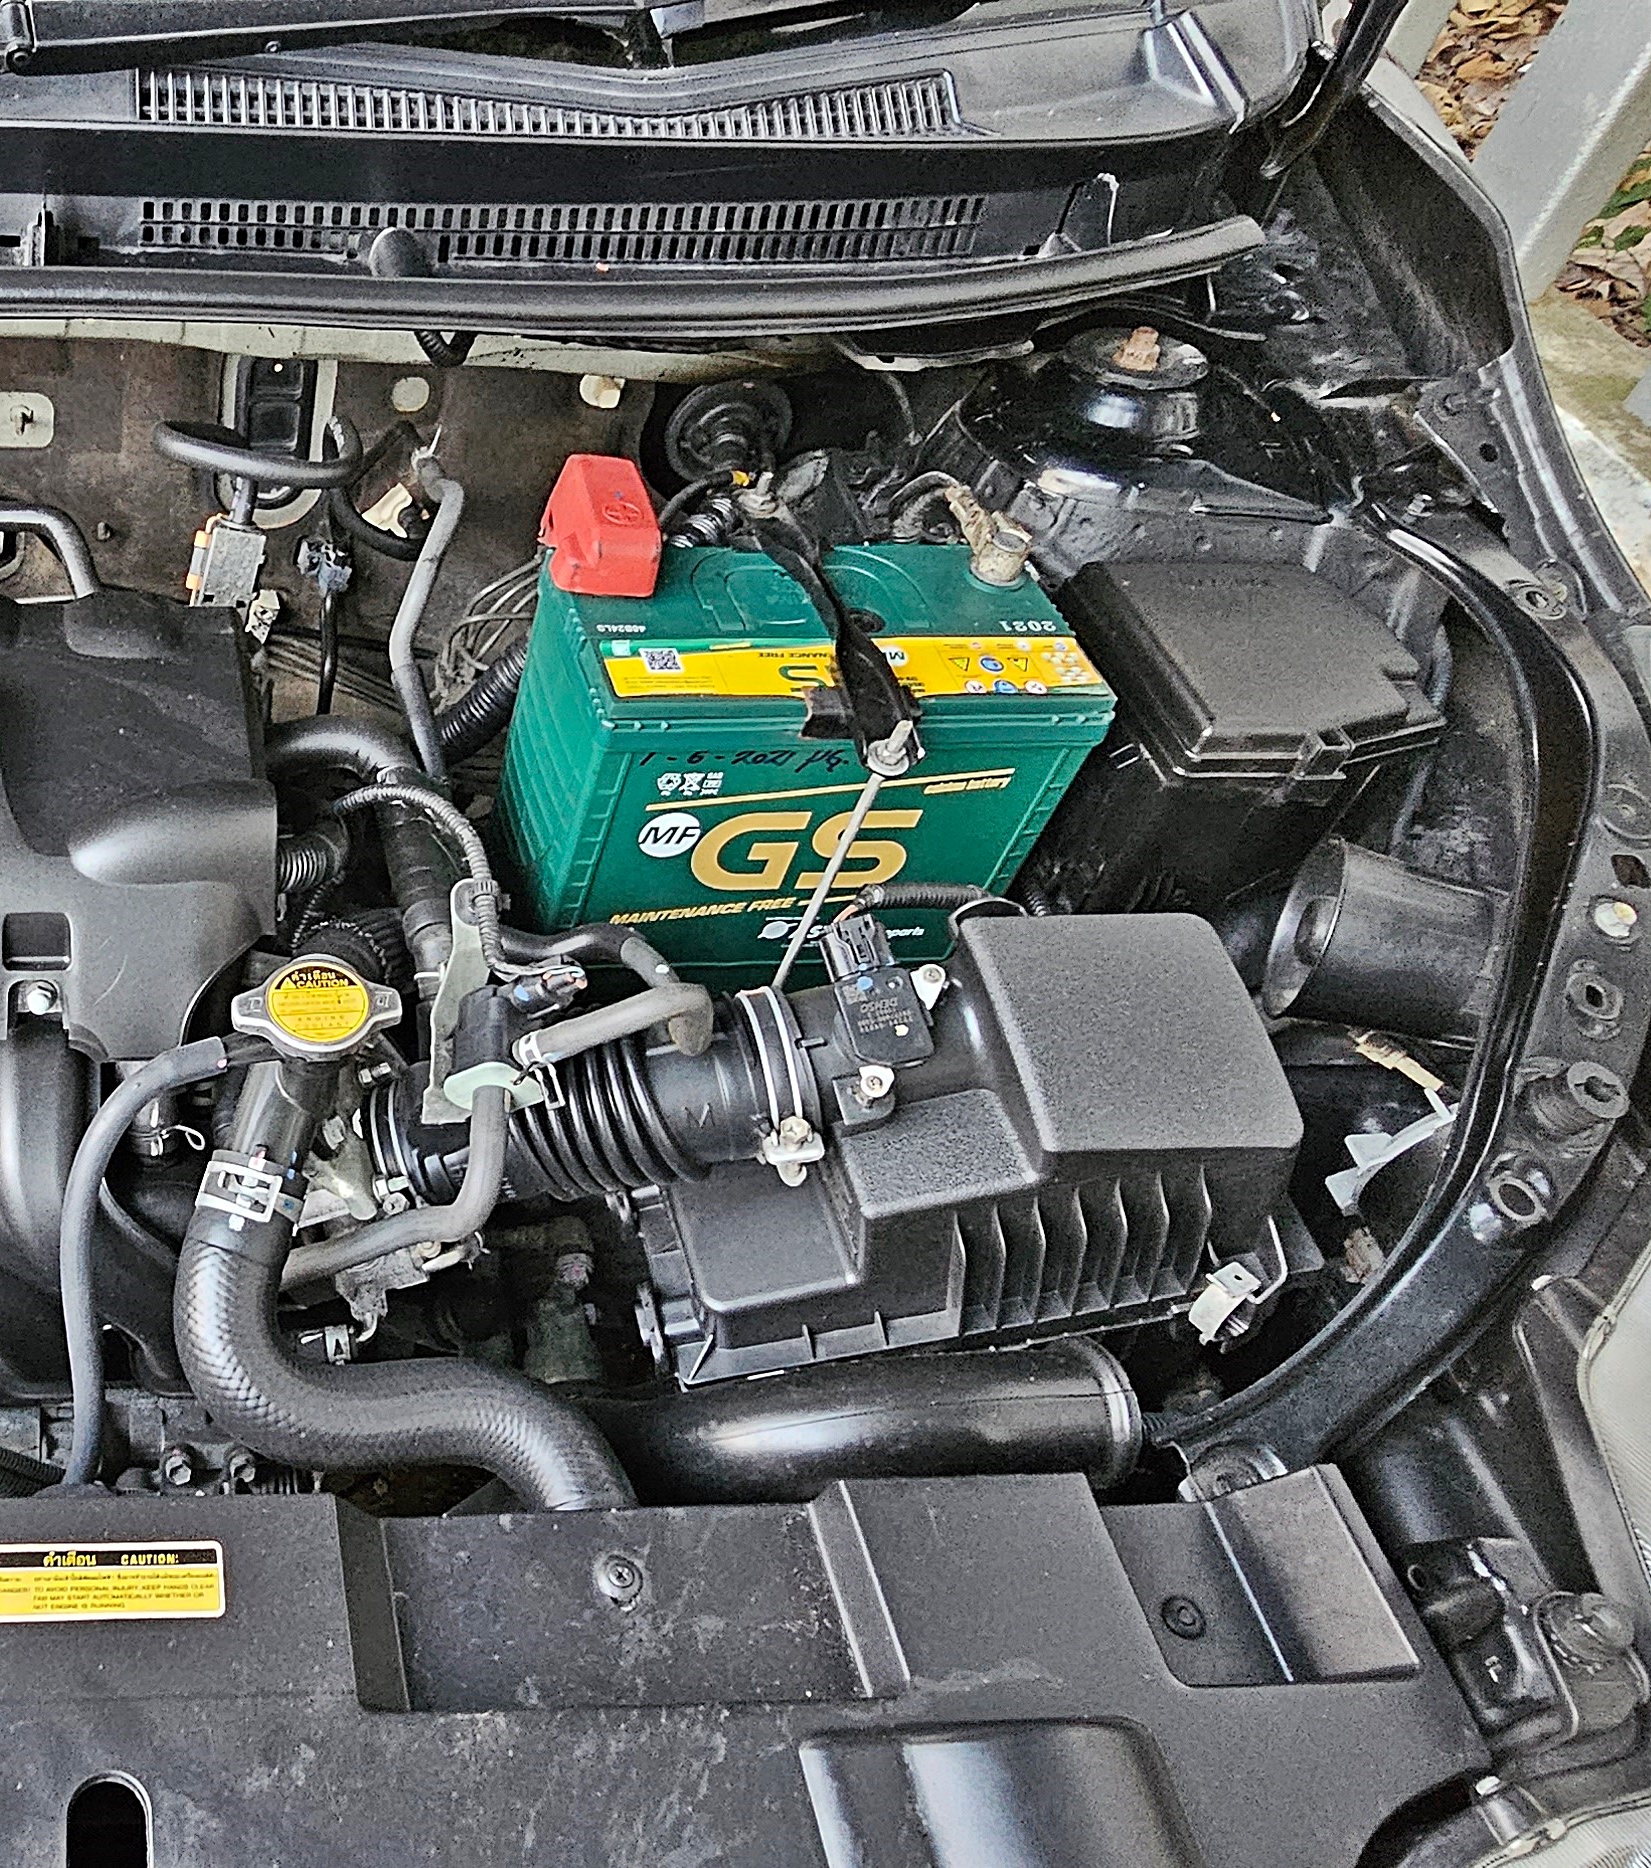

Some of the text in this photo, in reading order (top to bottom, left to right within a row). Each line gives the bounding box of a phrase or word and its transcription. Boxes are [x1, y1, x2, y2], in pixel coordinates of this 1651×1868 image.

[1000, 620, 1057, 632] 2021
[638, 826, 701, 844] MF
[691, 811, 924, 891] GS
[609, 896, 797, 925] MAINTENANCE FREE
[297, 979, 349, 988] CAUTION
